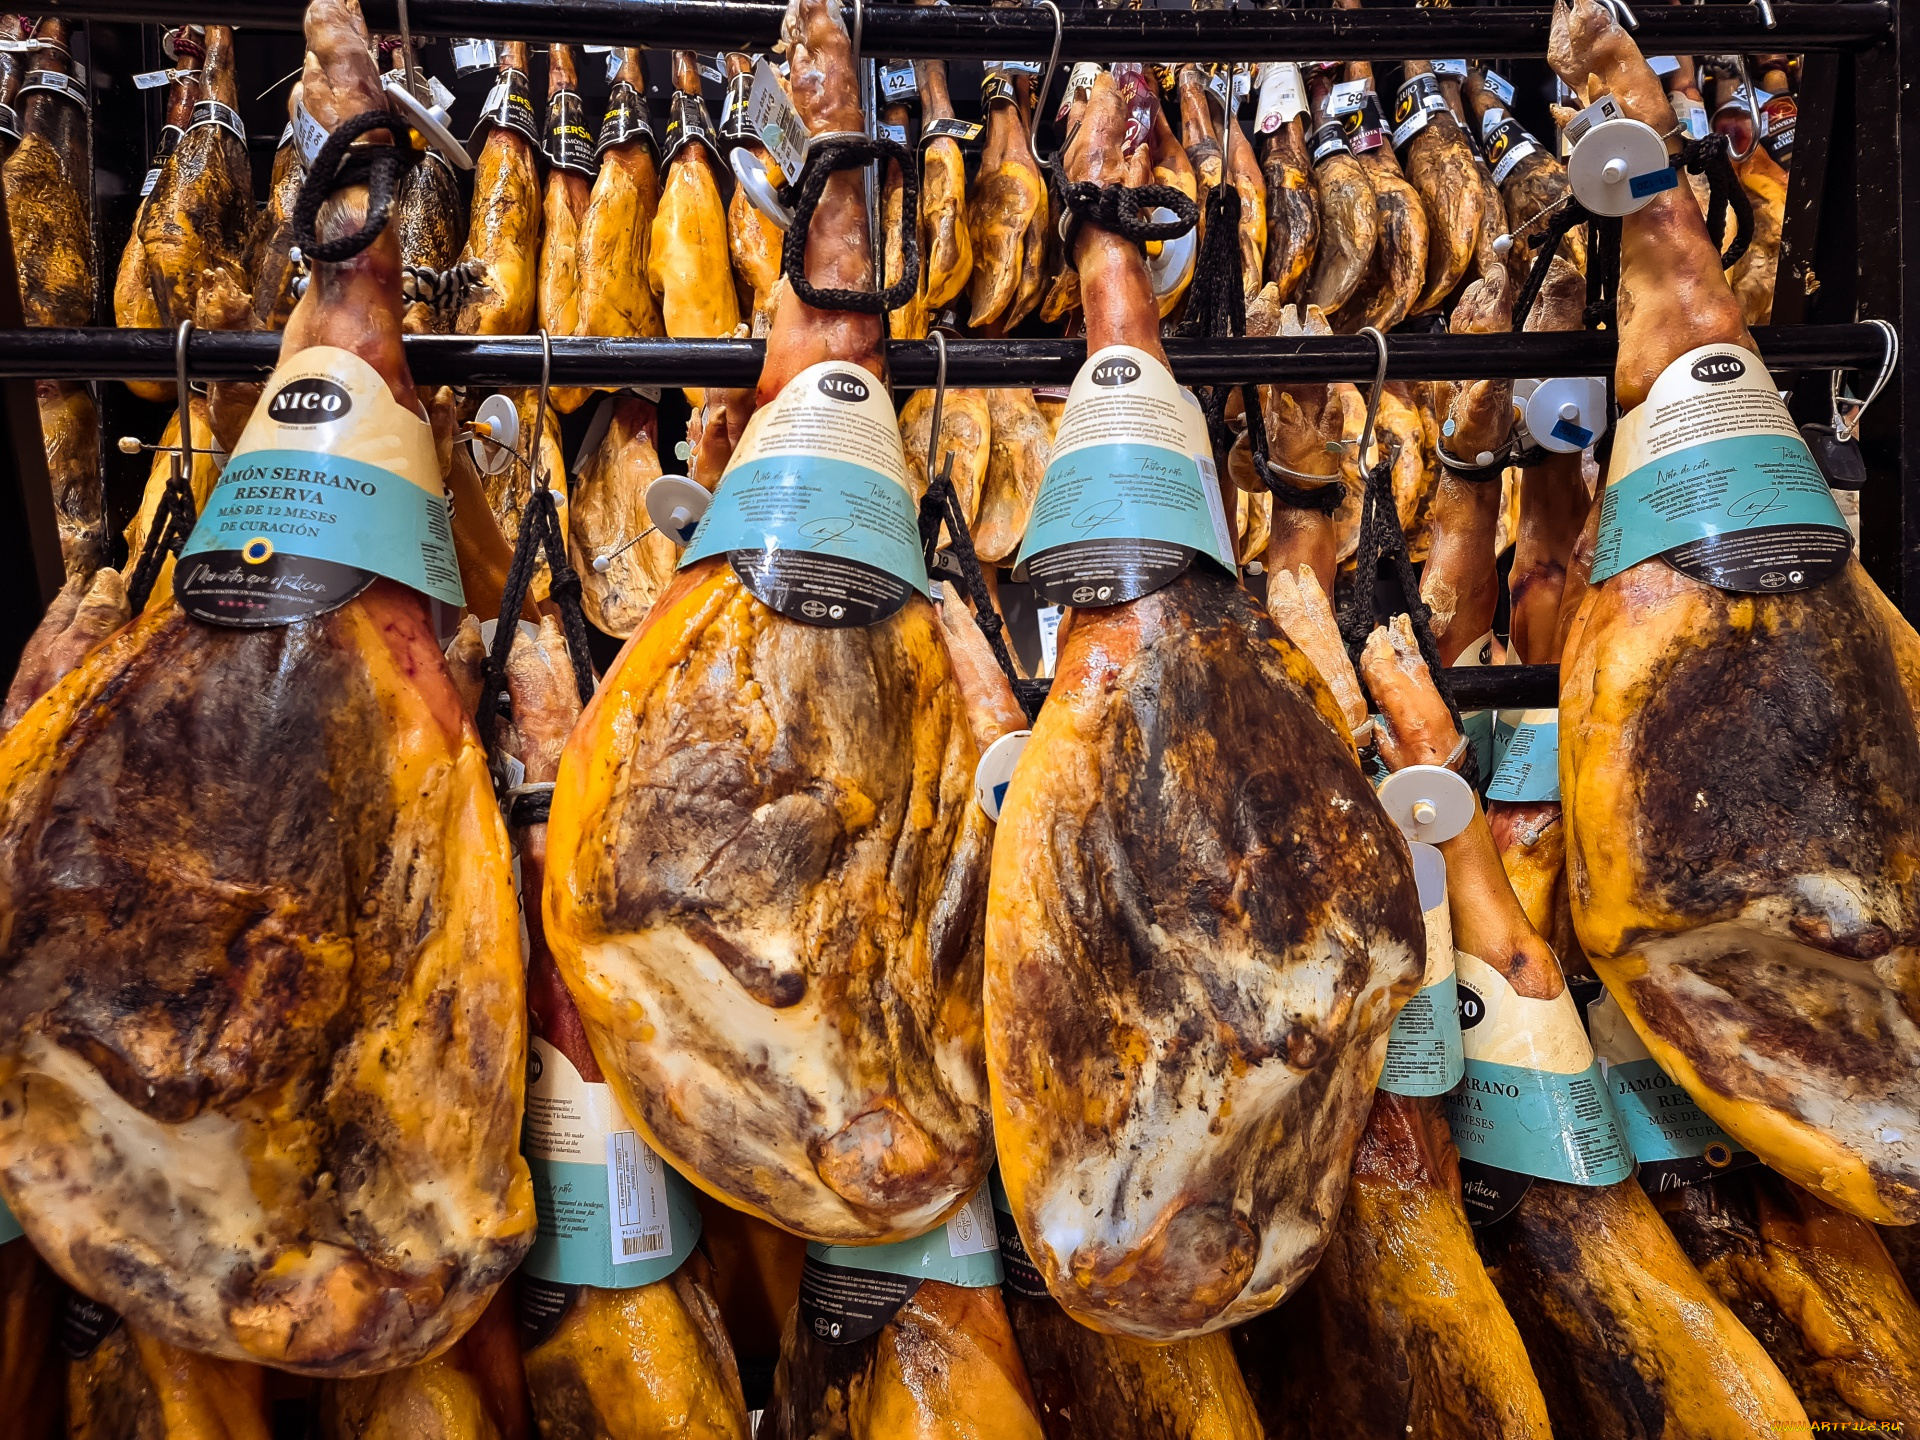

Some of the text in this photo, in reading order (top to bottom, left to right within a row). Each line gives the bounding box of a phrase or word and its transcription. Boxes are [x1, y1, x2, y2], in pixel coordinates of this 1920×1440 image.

[889, 75, 907, 89] 42
[1484, 80, 1500, 93] 52
[1095, 366, 1136, 380] NICO
[1696, 361, 1741, 378] NICO
[823, 379, 866, 397] NICO
[272, 392, 342, 412] NICO
[270, 467, 377, 496] SERRANO
[1657, 468, 1679, 485] Nota
[1680, 463, 1691, 473] de
[234, 486, 324, 505] RESERVA
[217, 504, 338, 524] MÁS DE 12 MESES
[219, 520, 320, 537] DE CURACIÓN
[1460, 1113, 1495, 1130] MESES
[1648, 1110, 1700, 1126] MÁS DE
[1663, 1129, 1683, 1140] DE
